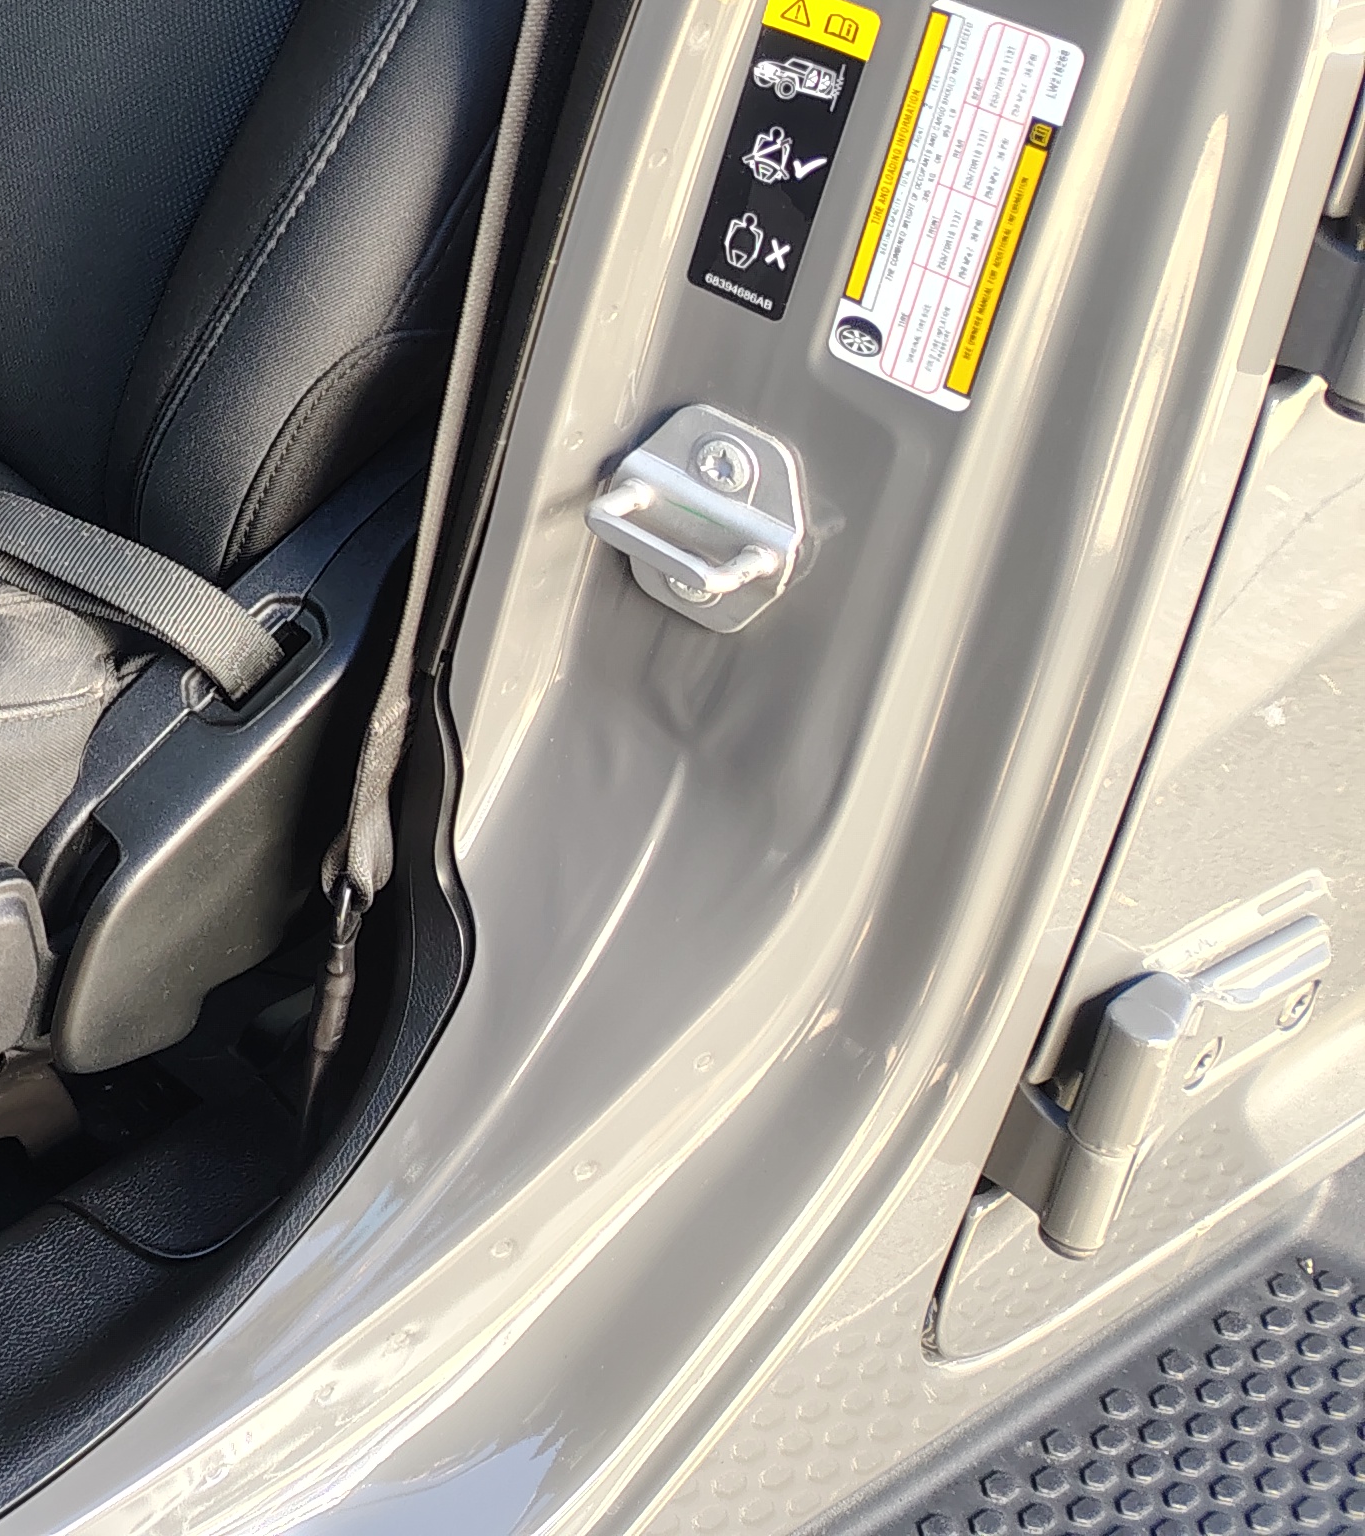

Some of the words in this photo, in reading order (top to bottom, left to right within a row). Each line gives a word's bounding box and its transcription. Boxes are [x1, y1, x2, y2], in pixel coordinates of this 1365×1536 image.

[894, 87, 921, 148] INFORMATION
[882, 146, 902, 185] LOADING
[876, 185, 890, 205] AND
[869, 204, 884, 226] TIRE
